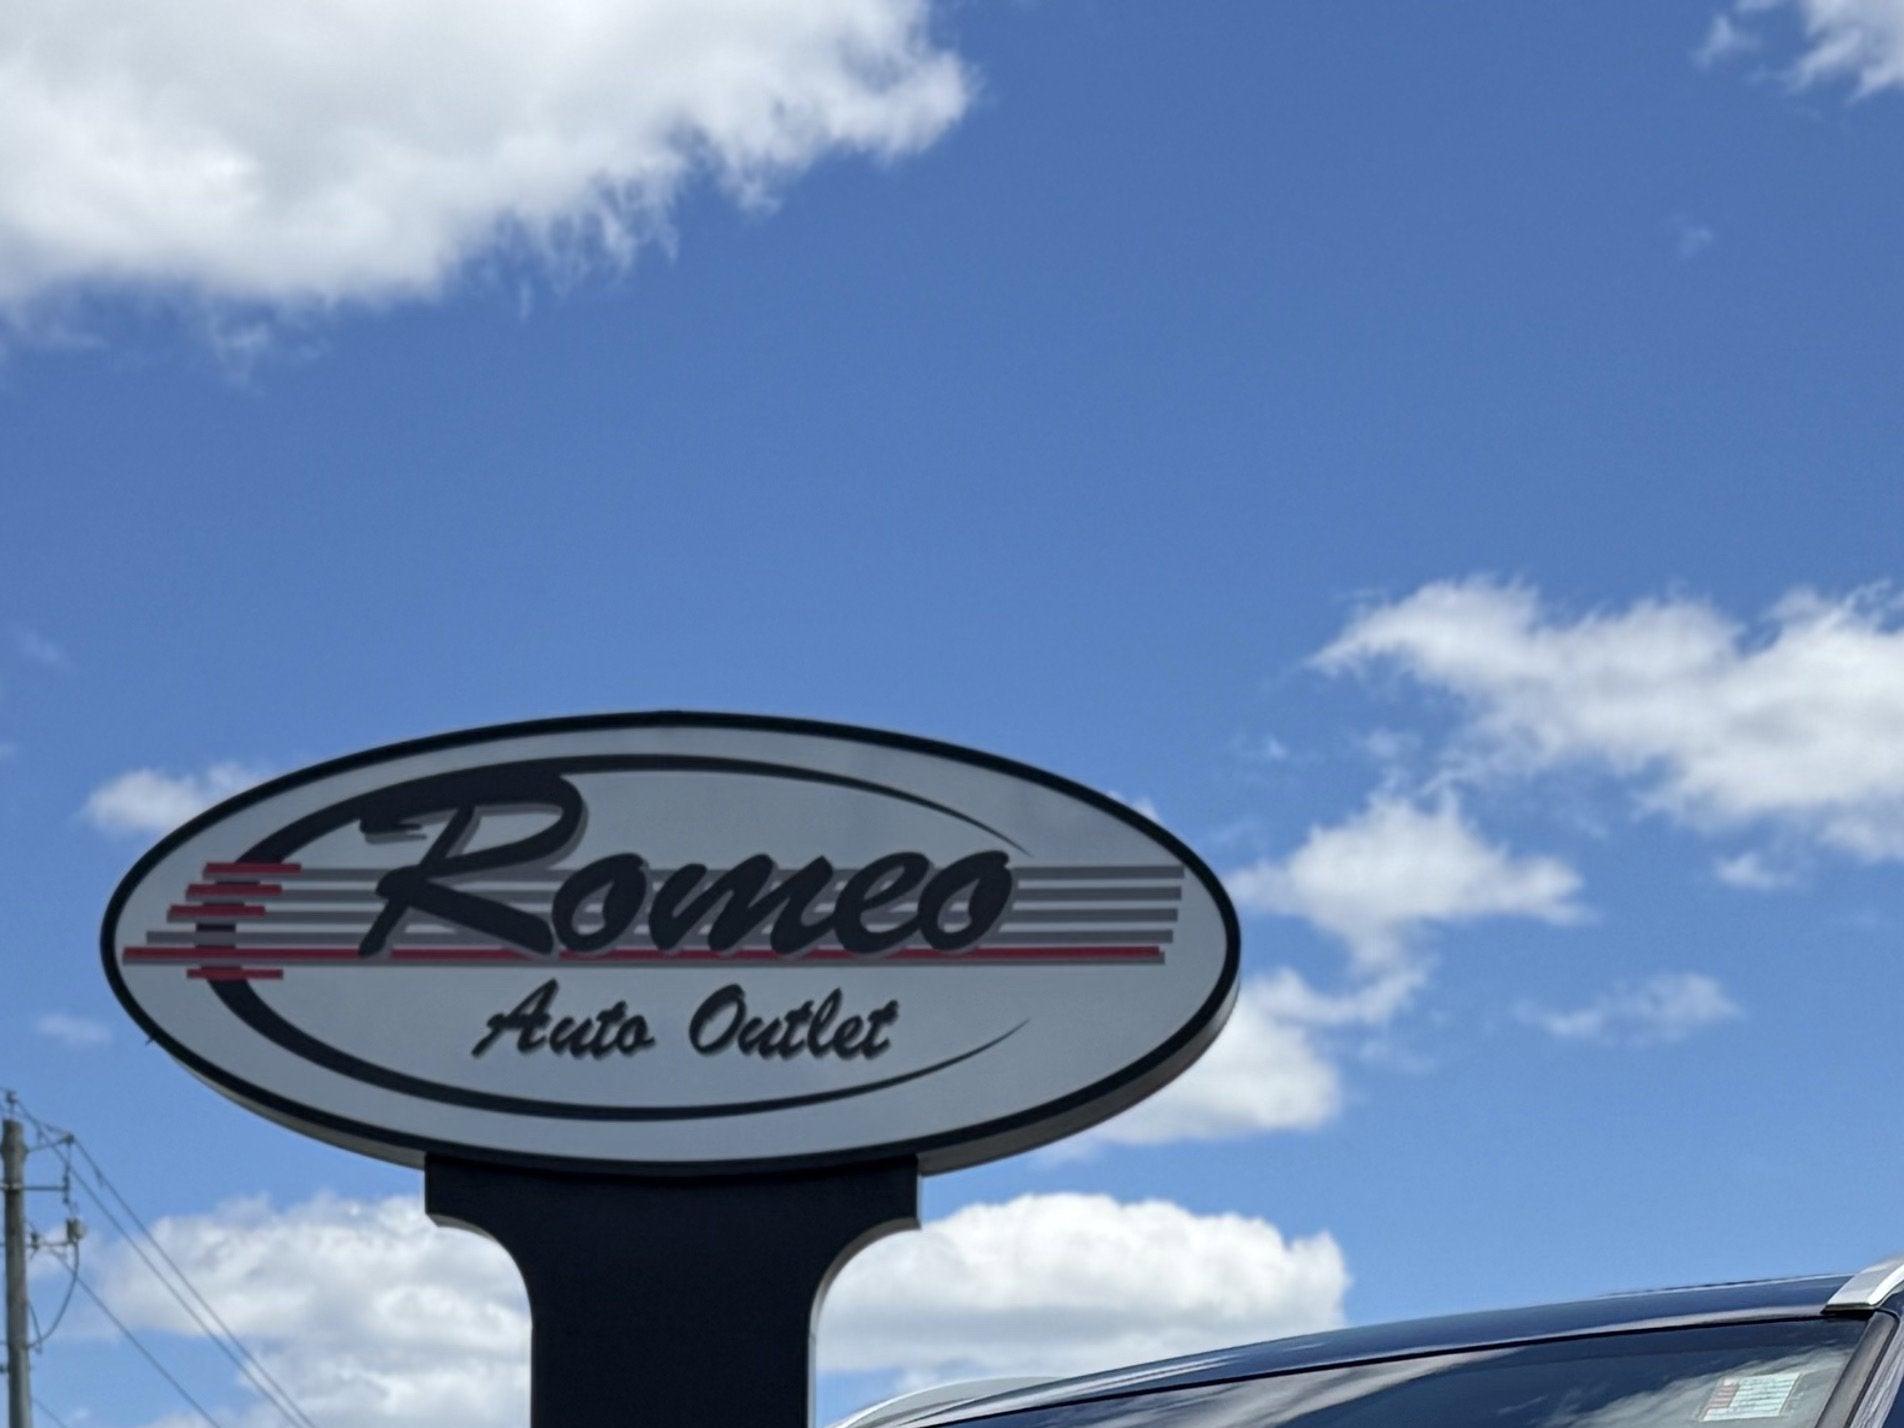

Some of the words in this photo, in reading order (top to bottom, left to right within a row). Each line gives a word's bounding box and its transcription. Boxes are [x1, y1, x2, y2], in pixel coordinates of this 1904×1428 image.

[358, 768, 1016, 957] Romeo
[472, 978, 656, 1057] Auto
[688, 984, 899, 1060] Outlet
